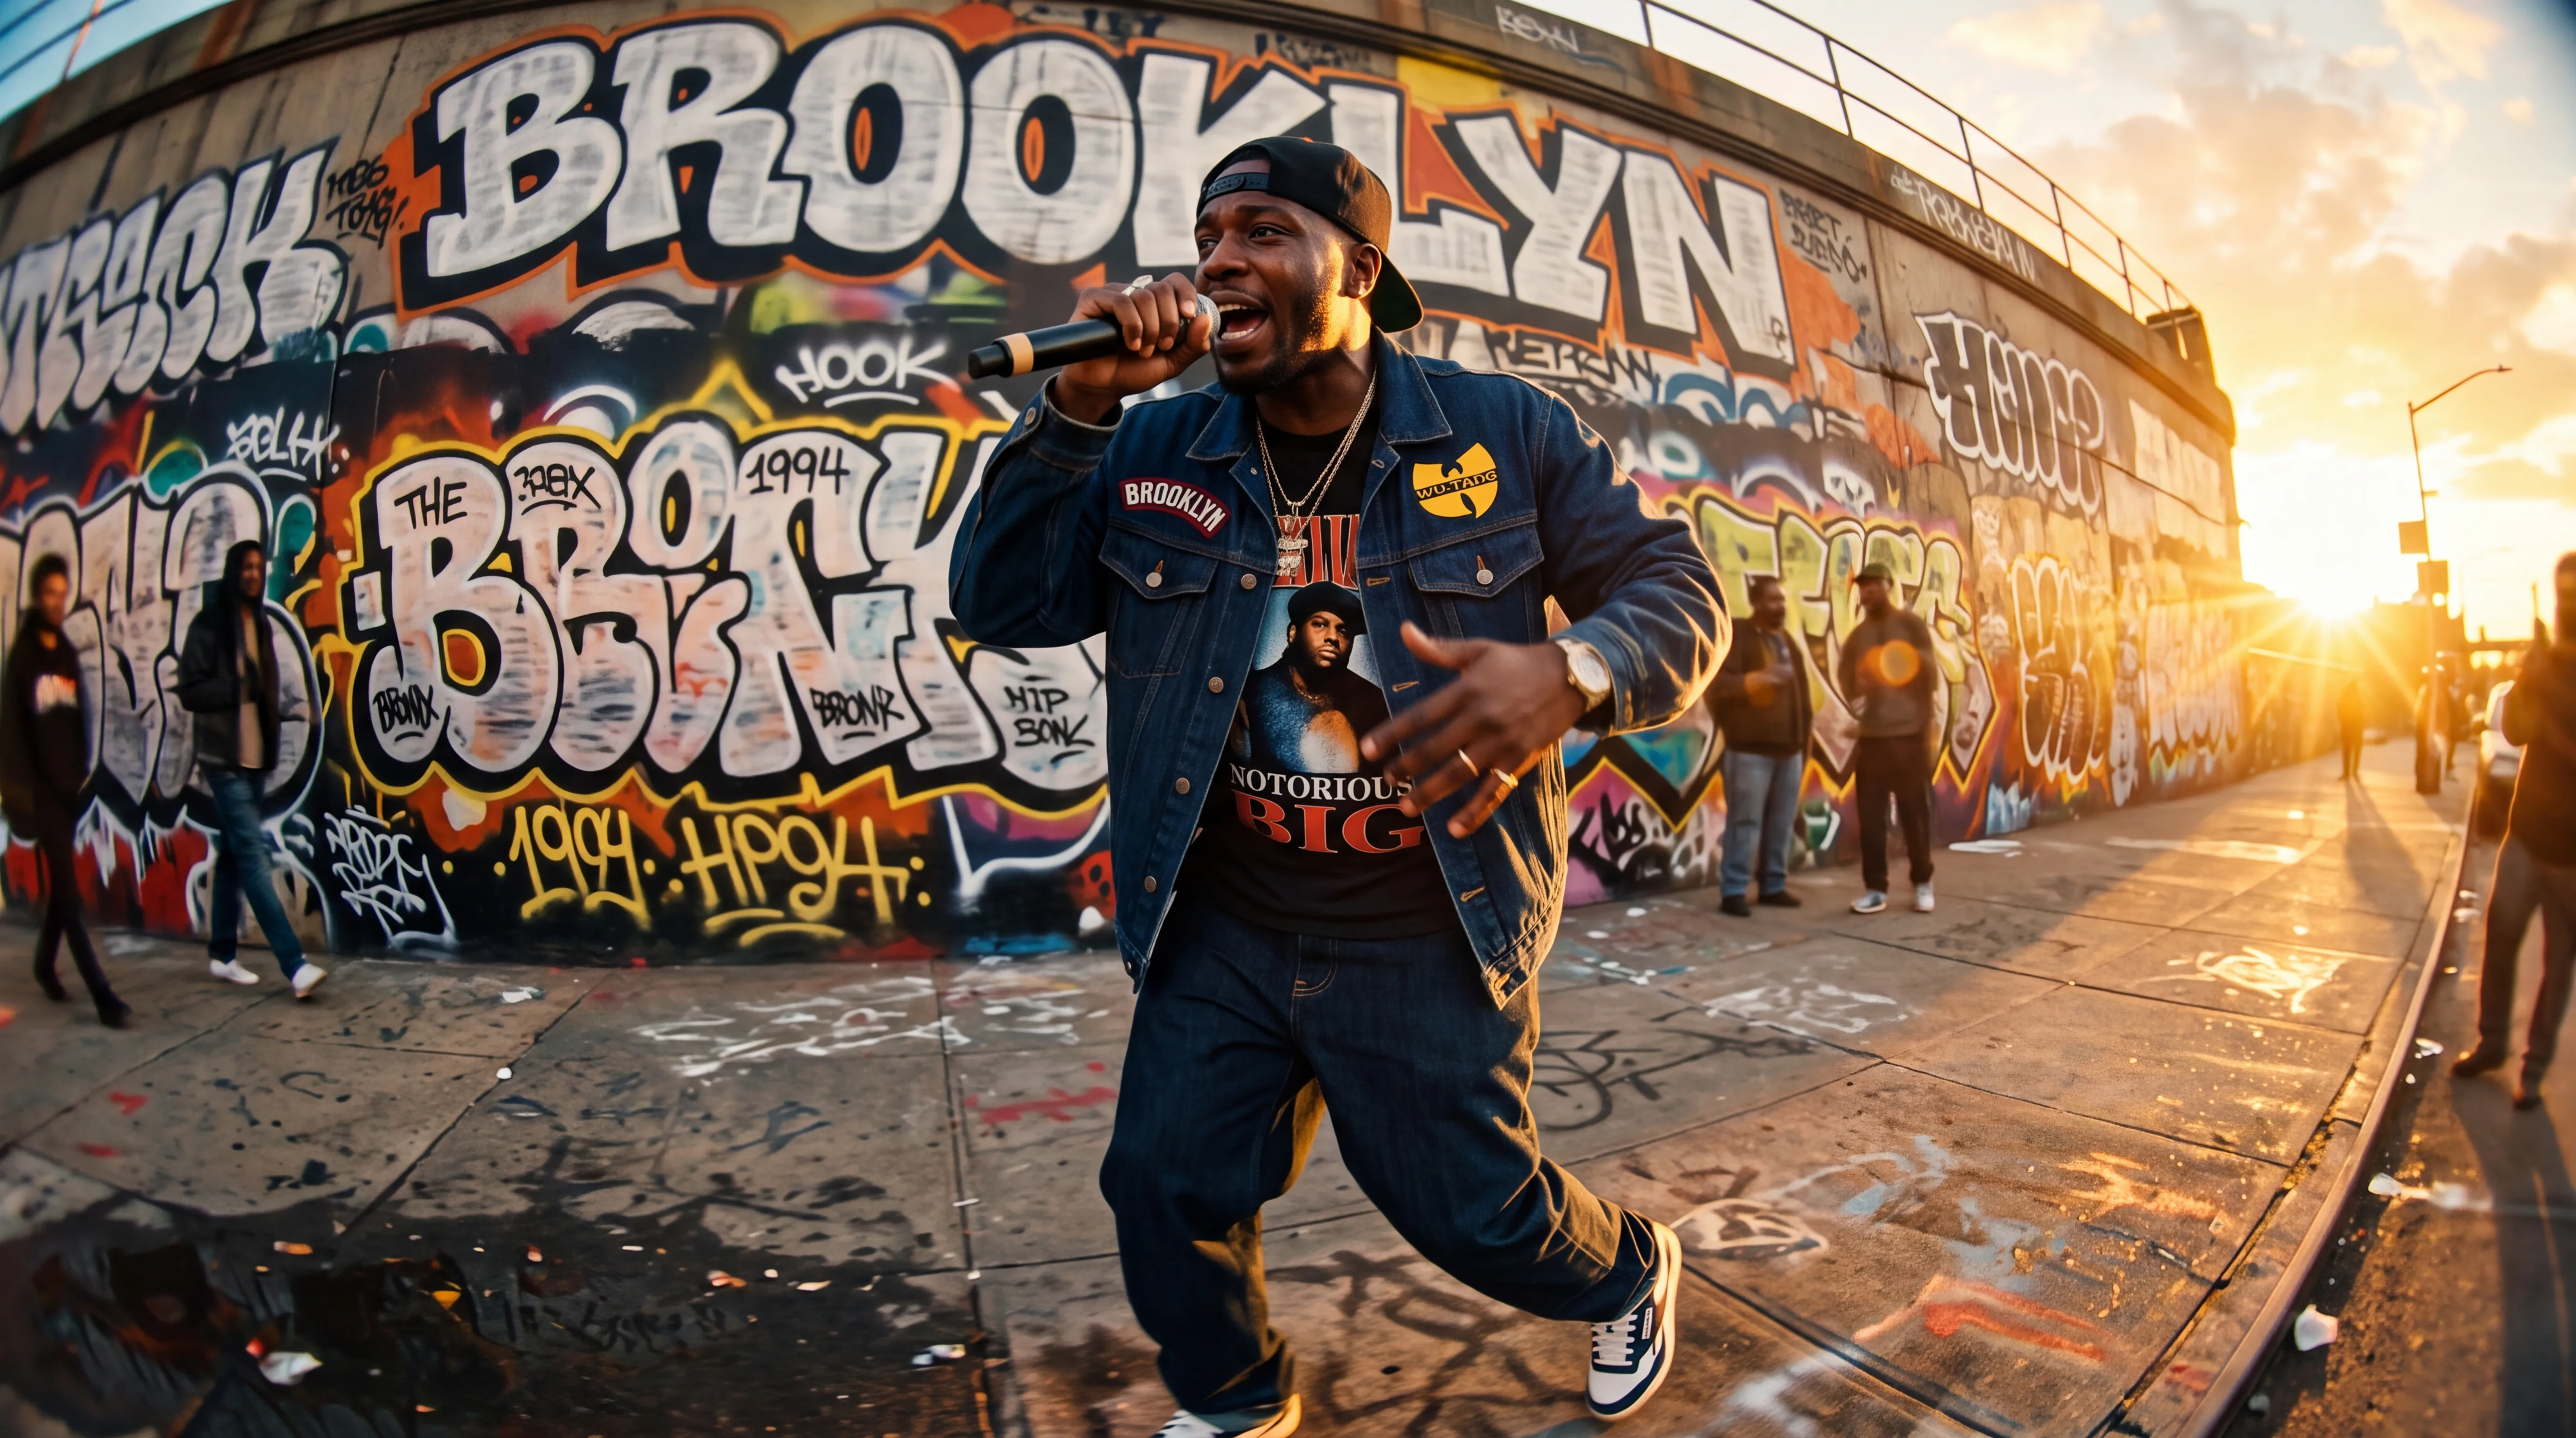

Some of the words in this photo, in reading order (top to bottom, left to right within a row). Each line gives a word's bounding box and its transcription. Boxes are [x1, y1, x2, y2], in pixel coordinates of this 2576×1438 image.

[425, 21, 1797, 367] BROOKLYN
[775, 335, 962, 404] HOOK
[746, 446, 850, 495] 1994
[394, 476, 468, 529] THE
[1125, 482, 1226, 532] BROOKLYN
[1230, 788, 1425, 854] BIG
